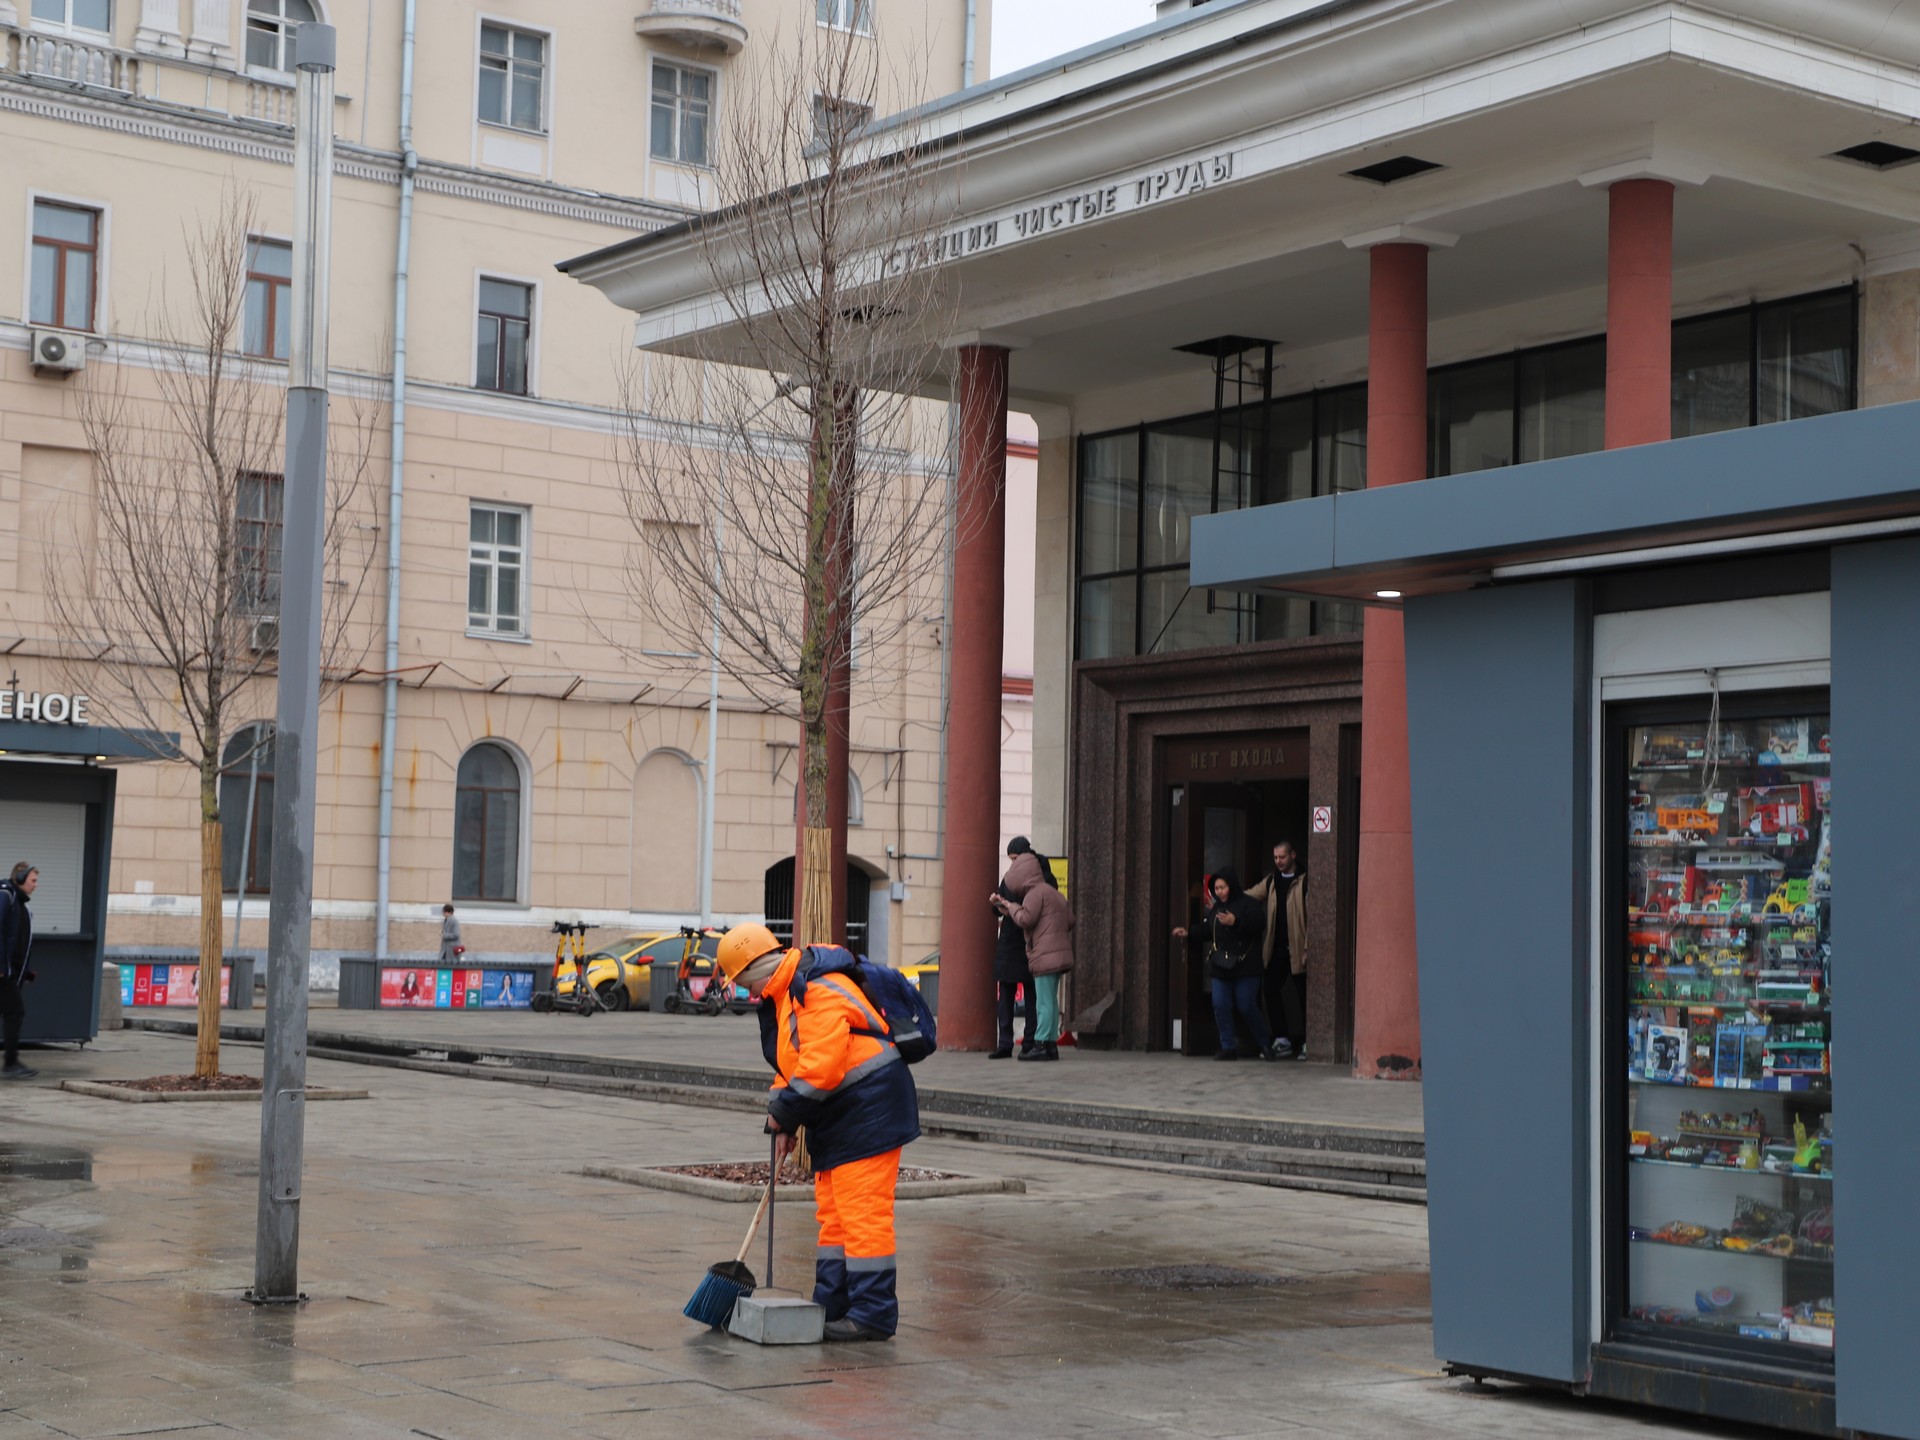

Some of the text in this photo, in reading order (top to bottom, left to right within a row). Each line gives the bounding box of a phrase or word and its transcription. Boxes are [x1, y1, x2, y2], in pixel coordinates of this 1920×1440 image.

[1013, 186, 1117, 236] ЧИСТЫЕ
[1134, 152, 1234, 204] ПРУДЫ
[0, 690, 89, 724] ЕНОЕ
[1190, 747, 1285, 769] НЕТ ВХОДА
